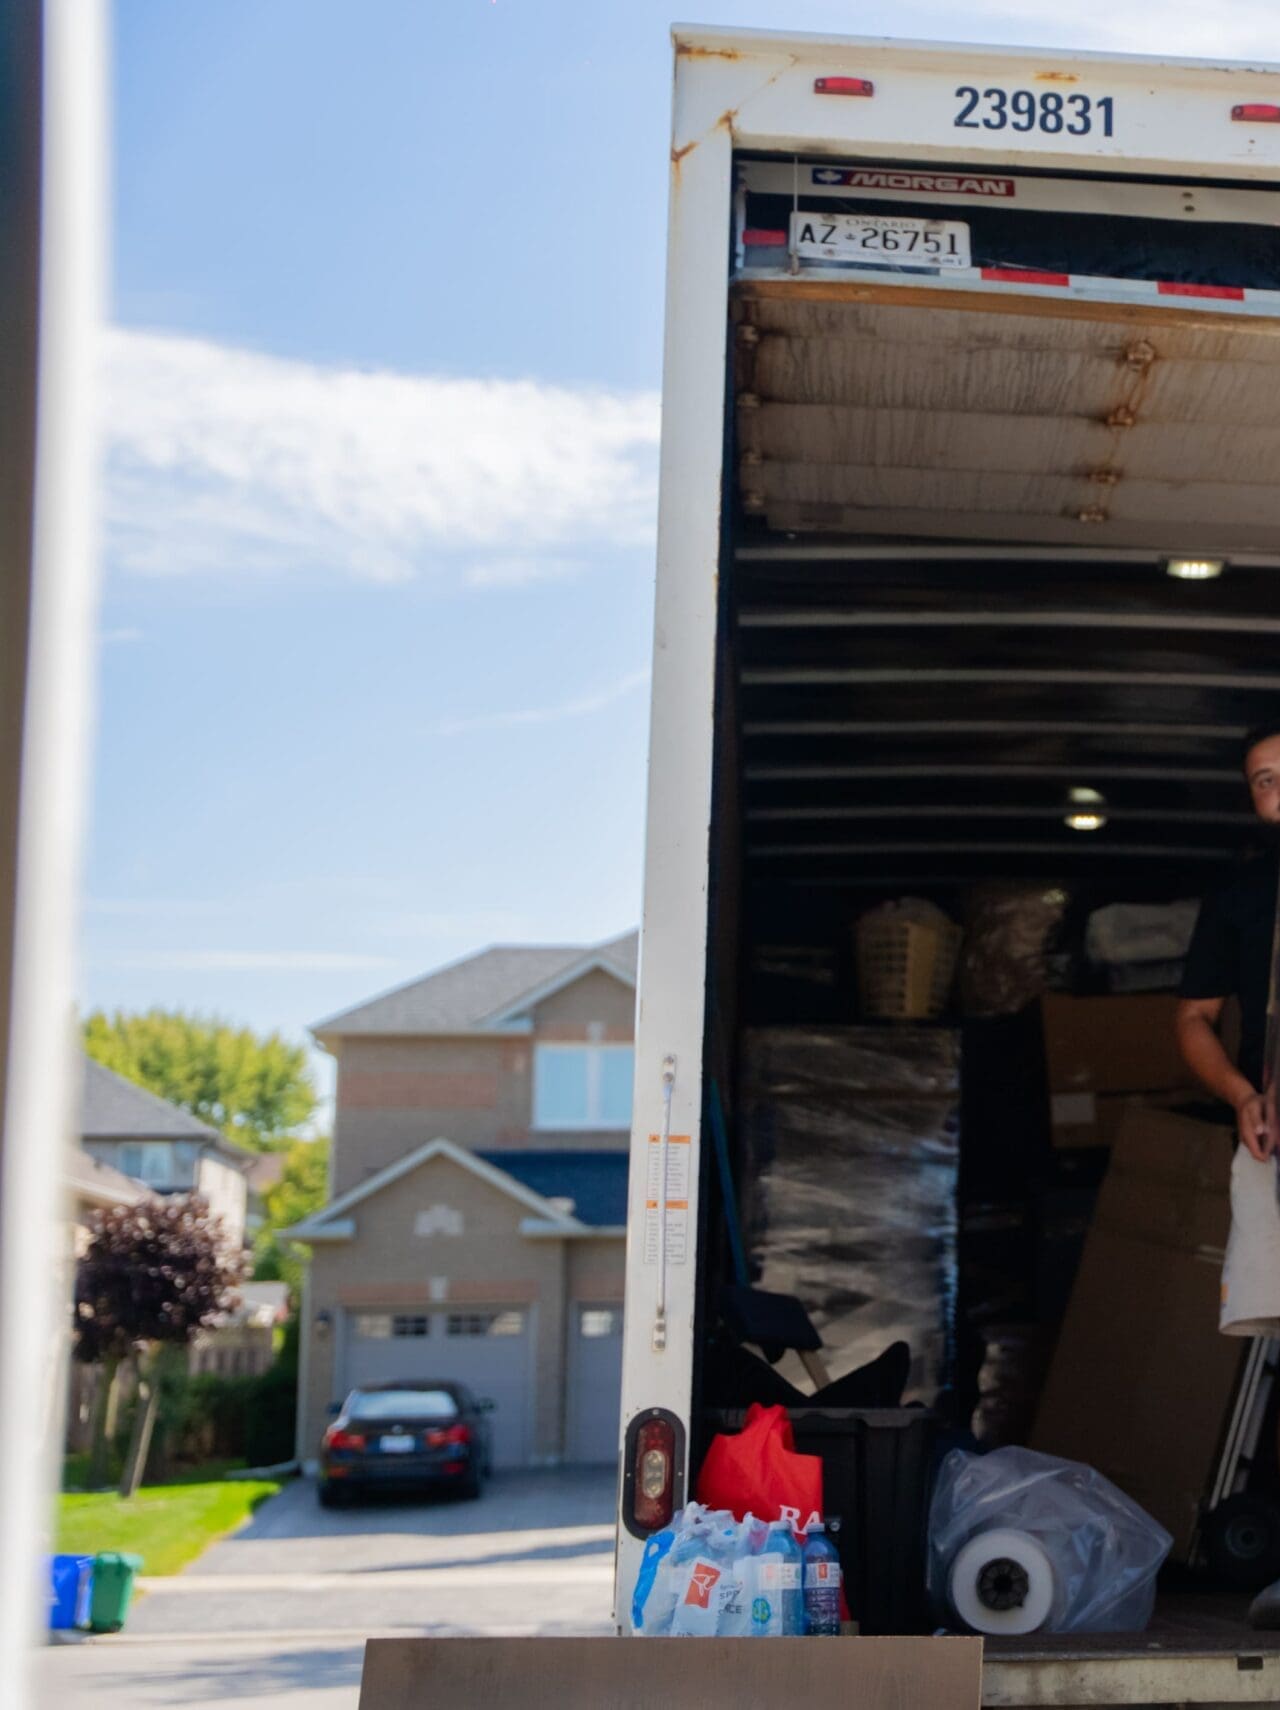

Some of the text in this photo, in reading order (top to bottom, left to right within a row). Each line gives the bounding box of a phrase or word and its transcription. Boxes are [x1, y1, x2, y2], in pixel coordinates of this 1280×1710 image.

[953, 86, 1114, 138] 239831
[850, 172, 1007, 194] MORGAN
[846, 217, 917, 229] ONTARIO
[799, 223, 959, 255] AZ 26751
